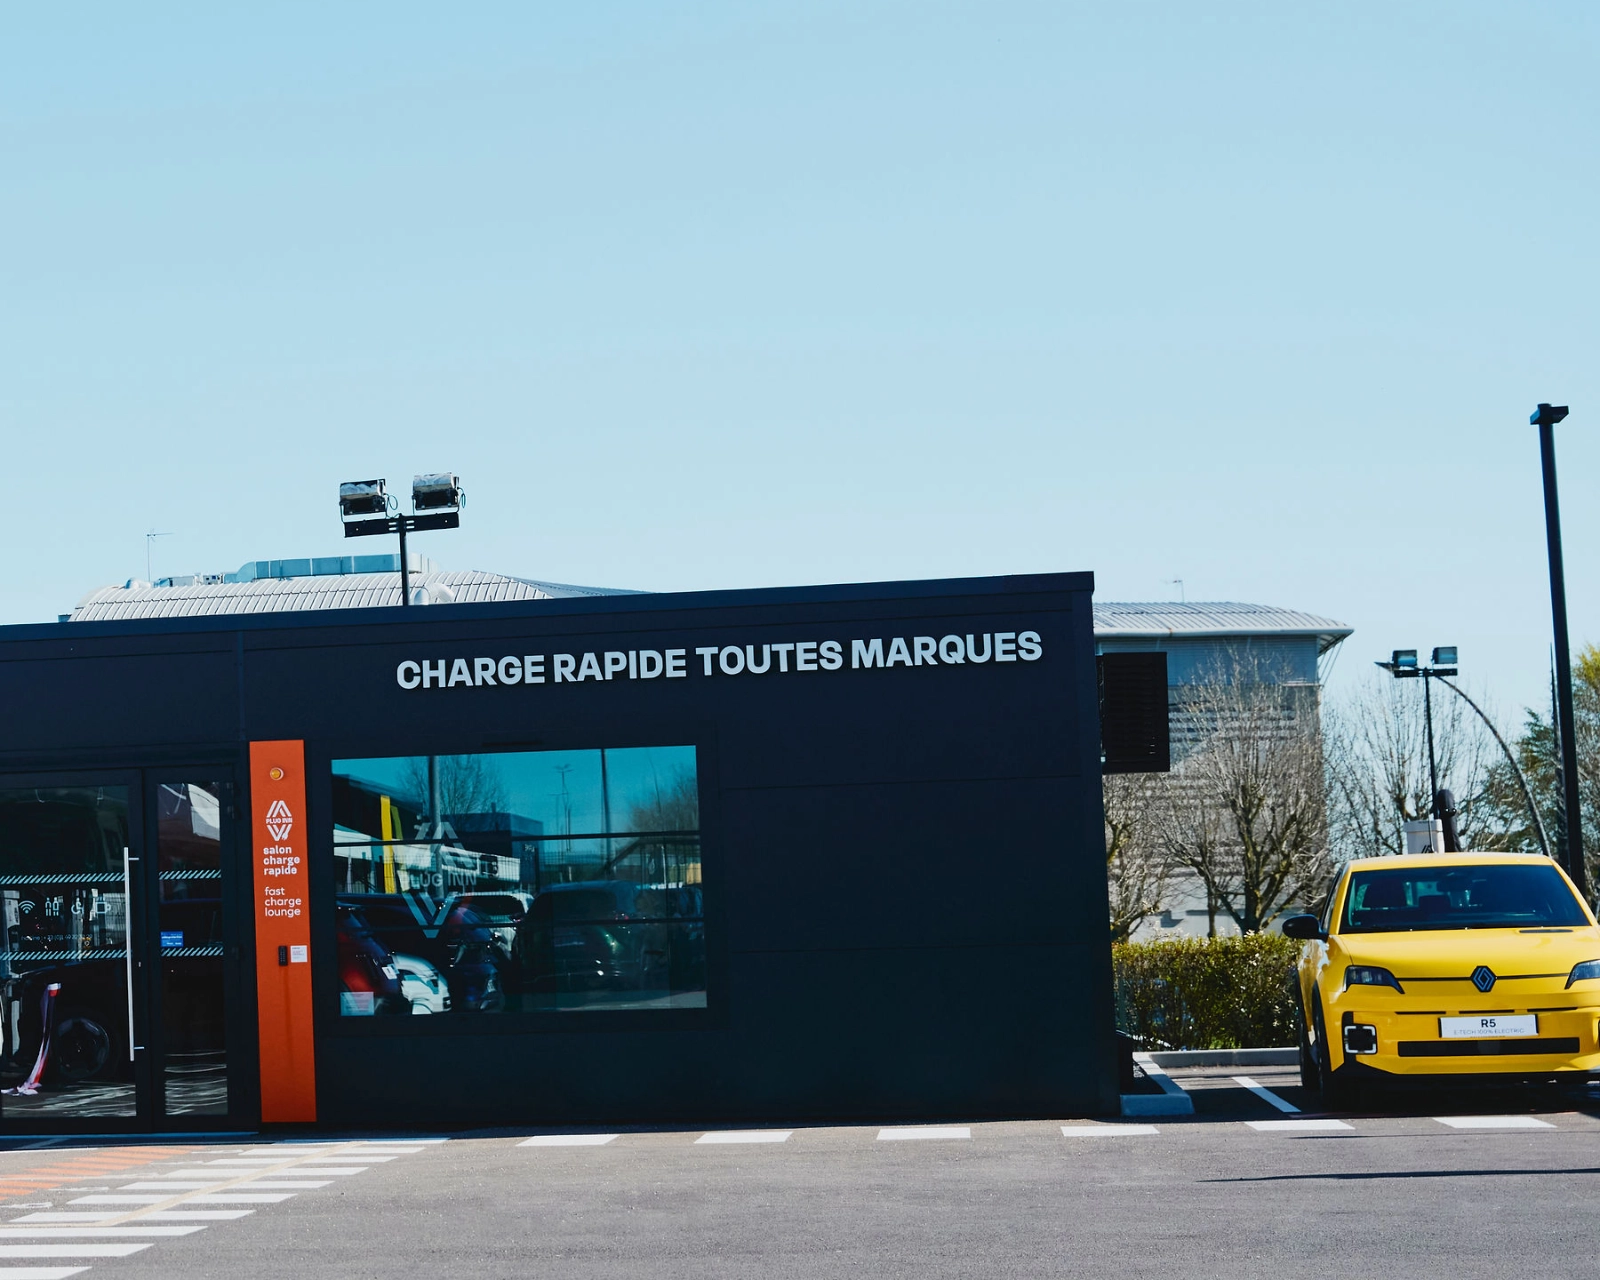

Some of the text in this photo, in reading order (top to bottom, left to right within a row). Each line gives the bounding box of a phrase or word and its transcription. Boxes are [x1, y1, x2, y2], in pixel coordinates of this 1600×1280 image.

[396, 630, 1043, 690] CHARGE RAPIDE TOUTES MARQUES
[263, 845, 292, 855] salon
[263, 856, 301, 866] charge
[263, 866, 298, 878] rapide
[448, 872, 477, 886] INN
[264, 886, 285, 896] fast
[264, 897, 302, 908] charge
[264, 907, 301, 918] lounge
[1480, 1018, 1497, 1028] R5
